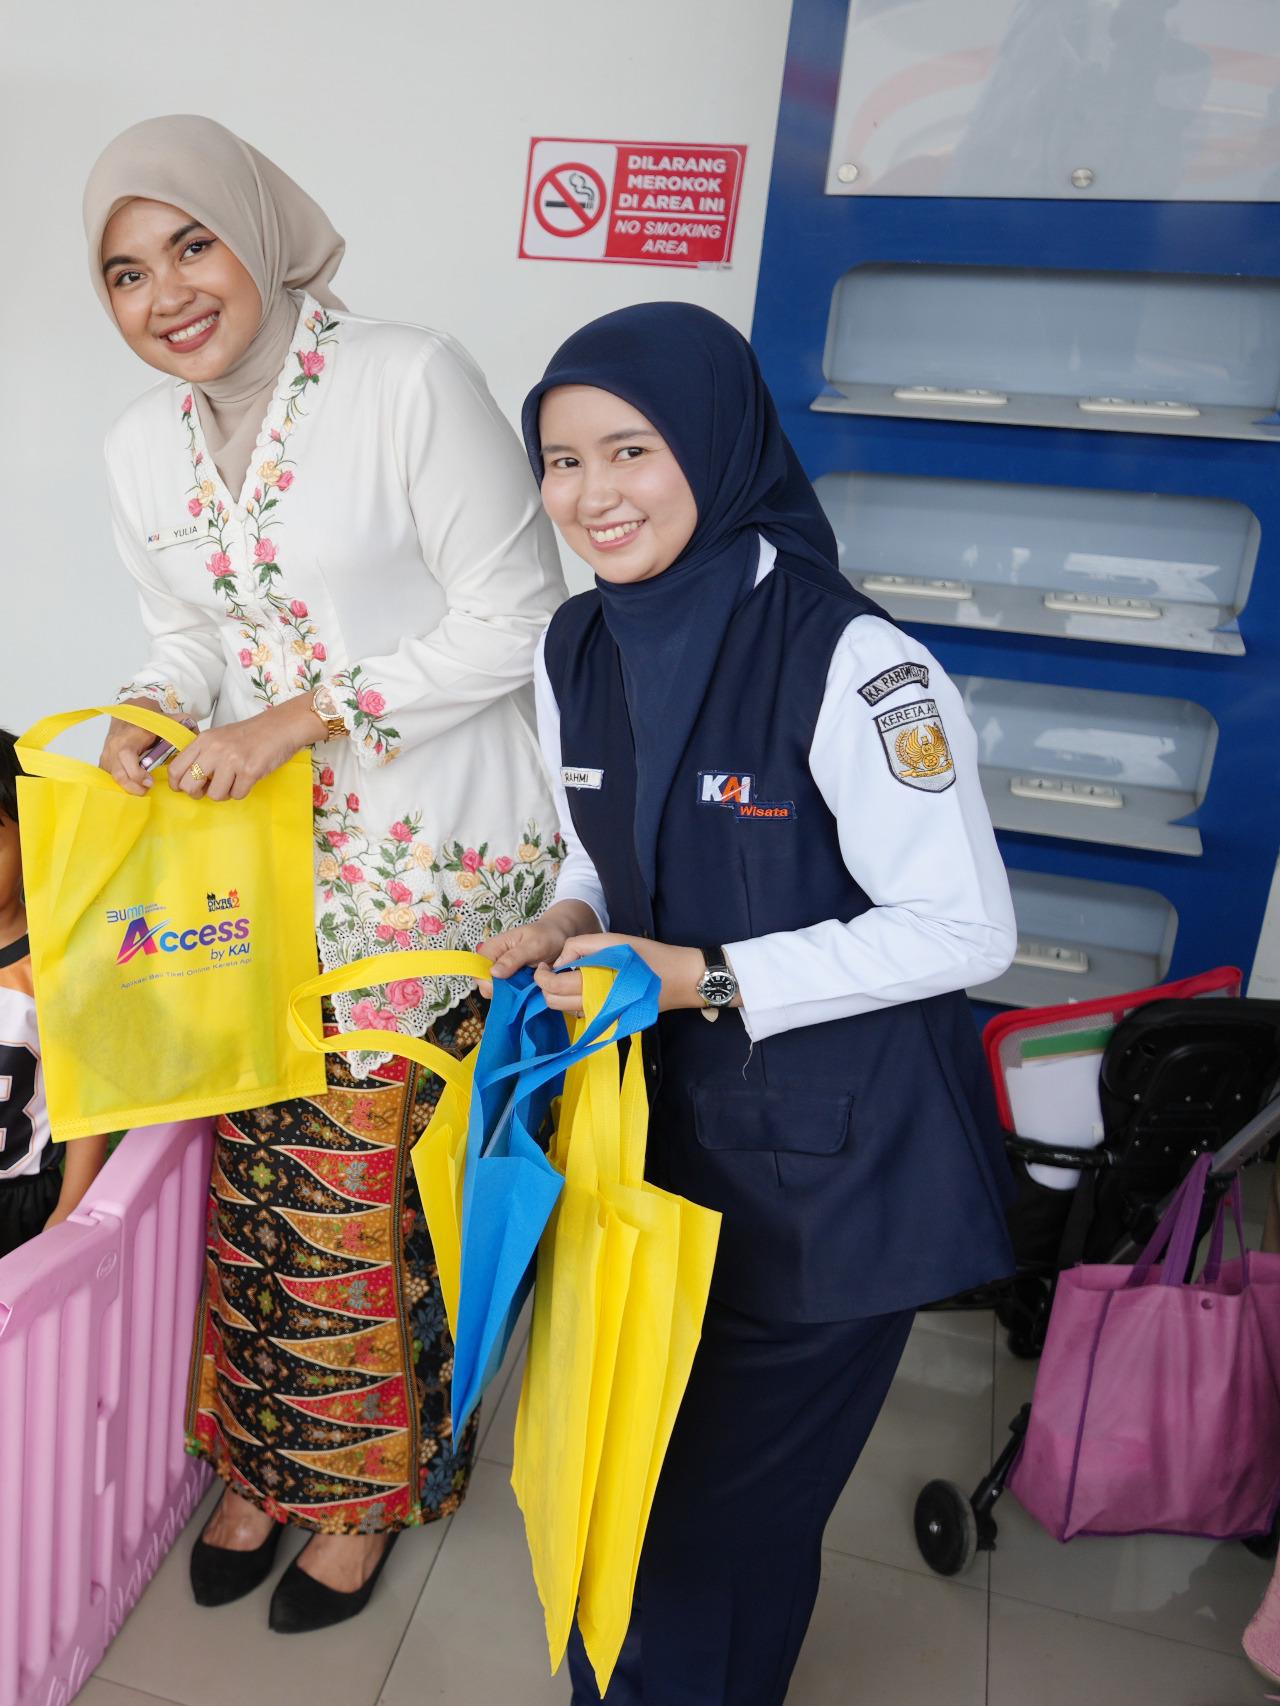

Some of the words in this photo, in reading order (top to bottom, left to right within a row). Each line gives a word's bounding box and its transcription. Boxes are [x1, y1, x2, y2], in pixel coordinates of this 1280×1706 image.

[627, 154, 727, 173] DILARANG
[627, 174, 721, 193] MEROKOK
[618, 193, 640, 208] DI
[641, 194, 694, 211] AREA
[698, 197, 726, 213] INI
[615, 219, 641, 234] NO
[643, 221, 721, 239] SMOKING
[641, 240, 689, 255] AREA
[173, 525, 198, 538] YULIA
[864, 685, 883, 700] KA
[880, 705, 924, 729] KERETA
[564, 771, 589, 784] RAHMI
[701, 774, 751, 804] KAI
[739, 805, 789, 818] Wisata
[115, 916, 251, 966] Access
[210, 949, 226, 961] by
[228, 942, 251, 957] KAI
